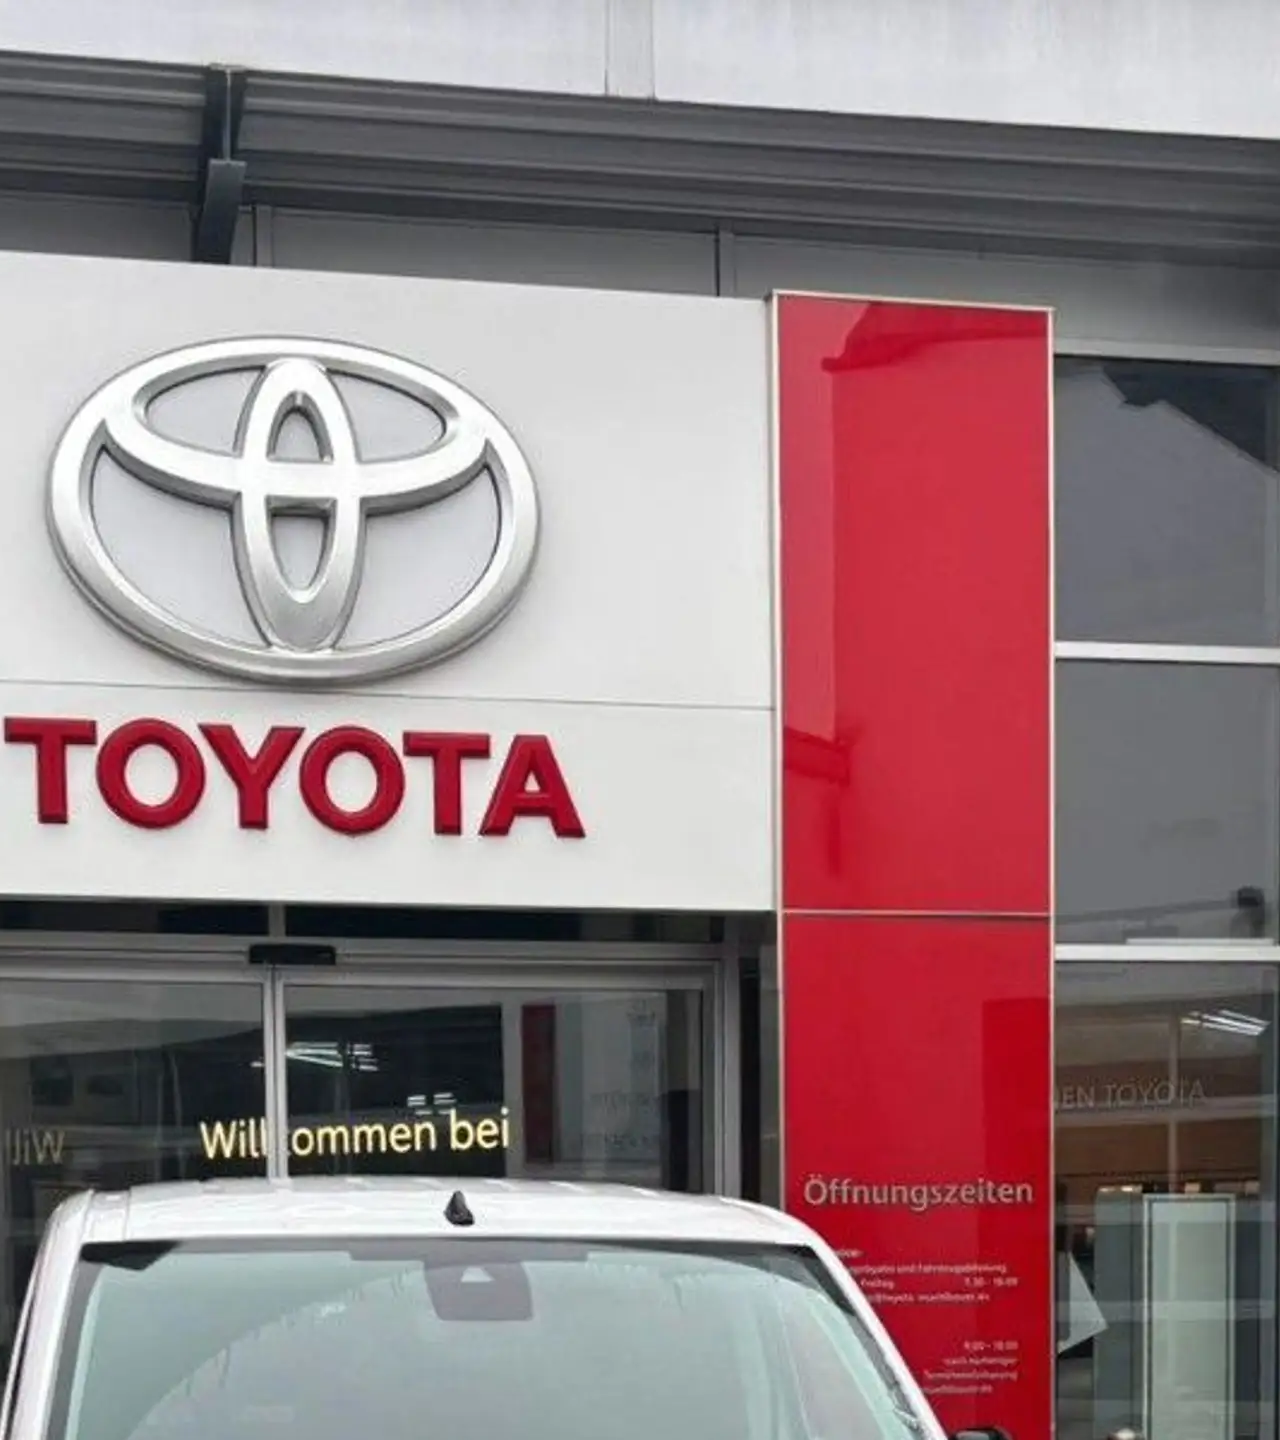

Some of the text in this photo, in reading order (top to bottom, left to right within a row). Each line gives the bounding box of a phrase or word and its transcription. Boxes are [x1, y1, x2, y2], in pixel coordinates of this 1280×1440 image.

[4, 717, 586, 838] TOYOTA
[200, 1107, 510, 1159] Willommen bei
[804, 1174, 1033, 1212] Öffnungszeiten
